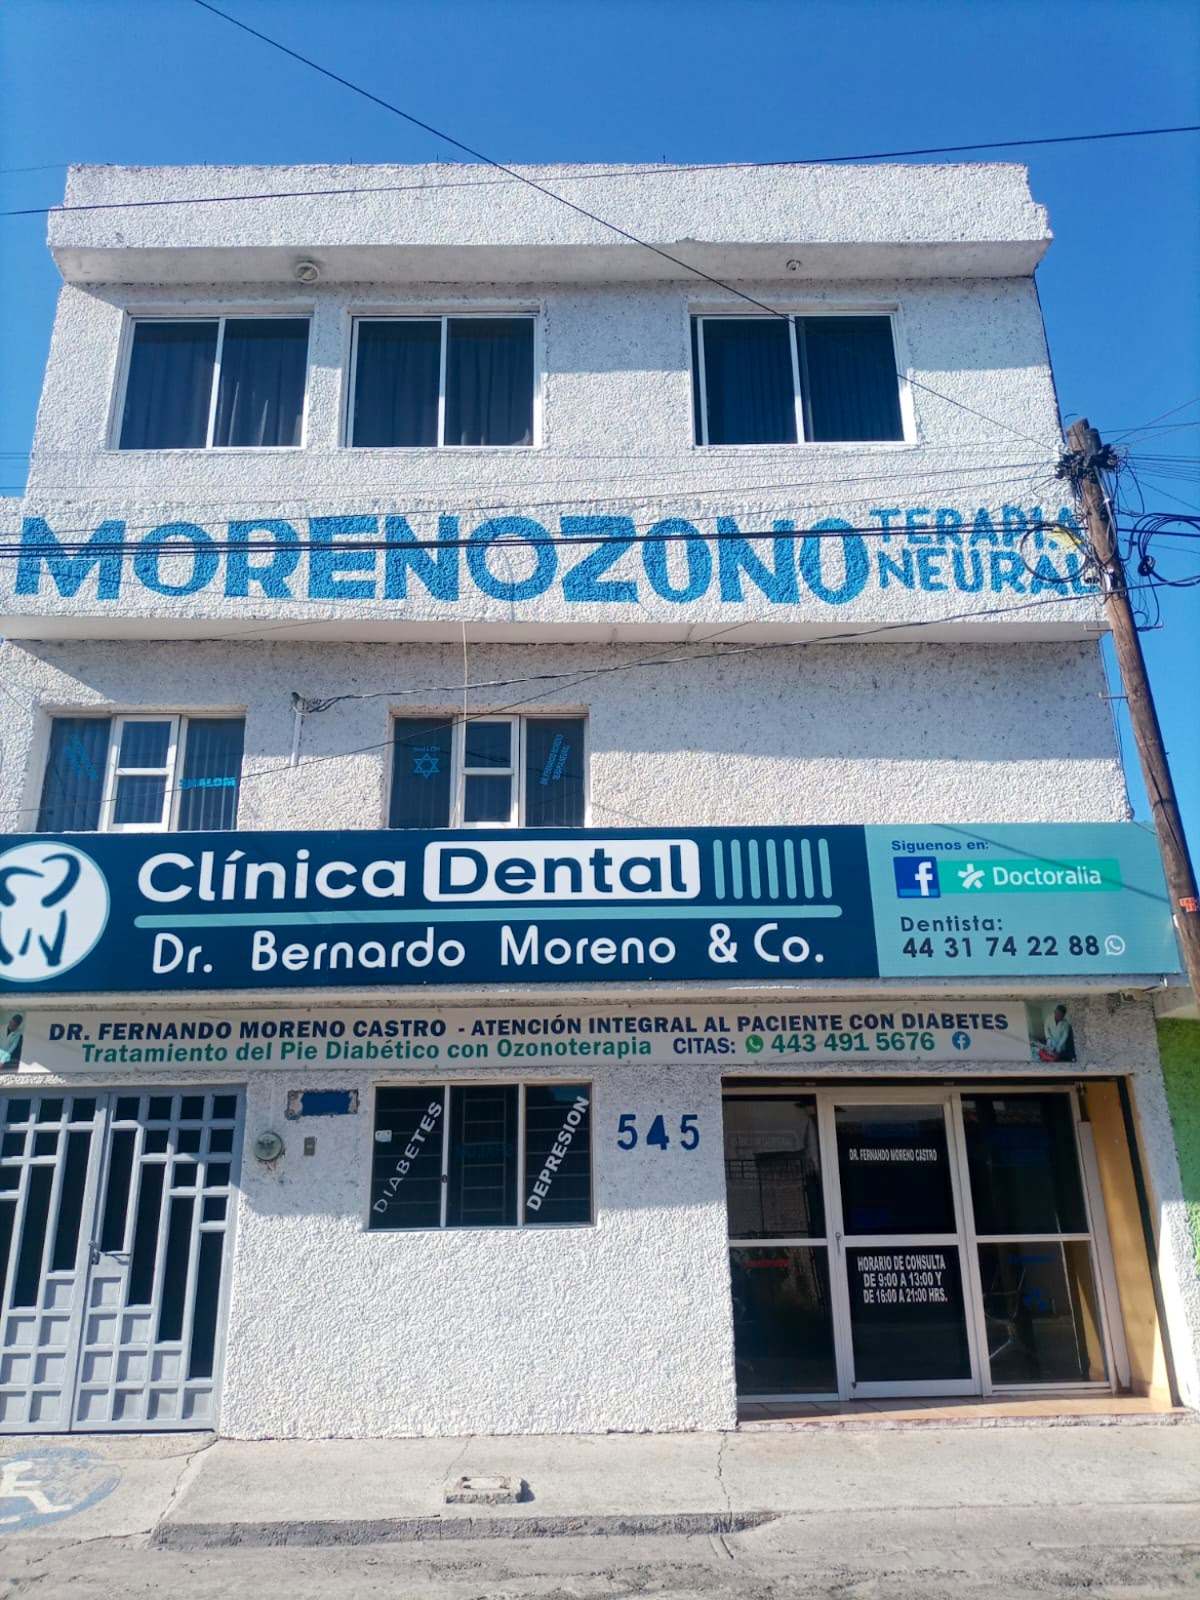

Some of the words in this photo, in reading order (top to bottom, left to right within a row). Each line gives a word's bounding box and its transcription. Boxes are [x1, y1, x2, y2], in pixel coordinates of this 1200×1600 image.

[869, 506, 1082, 549] TERAPIA
[14, 515, 870, 605] MORENOZONO
[877, 547, 1101, 596] NEURAL
[891, 840, 962, 853] Siguenos
[966, 841, 989, 850] en:
[138, 849, 406, 902] Clínica
[438, 844, 688, 895] Dental
[993, 867, 1102, 885] Doctoralia
[900, 916, 1003, 932] Dentista:
[151, 932, 214, 974] Dr.
[251, 927, 466, 972] Bernardo
[500, 924, 677, 967] Moreno
[708, 923, 738, 963] &
[754, 922, 825, 964] Co.
[903, 938, 934, 958] 44
[945, 938, 973, 957] 31
[986, 937, 1017, 956] 74
[1027, 936, 1059, 956] 22
[1069, 935, 1100, 956] 88
[49, 1023, 90, 1041] DR.
[98, 1022, 232, 1041] FERNANDO
[240, 1020, 346, 1039] MORENO
[352, 1019, 446, 1037] CASTRO
[471, 1014, 581, 1036] ATENCIÓN
[589, 1016, 697, 1034] INTEGRAL
[704, 1016, 730, 1033] AL
[737, 1014, 842, 1032] PACIENTE
[849, 1014, 895, 1031] CON
[902, 1013, 1008, 1030] DIABETES
[82, 1043, 228, 1063] Tratamiento
[236, 1042, 271, 1061] del
[281, 1042, 318, 1060] Pie
[326, 1039, 439, 1060] Diabético
[447, 1043, 489, 1058] con
[496, 1036, 652, 1059] Ozonoterapia
[673, 1037, 736, 1054] CITAS:
[771, 1034, 816, 1053] 443
[824, 1033, 870, 1052] 491
[876, 1032, 935, 1052] 5676
[617, 1113, 700, 1150] 545
[373, 1100, 442, 1214] DIABETES
[525, 1095, 590, 1212] DEPRESION
[849, 1148, 858, 1161] DR.
[860, 1148, 890, 1161] FERNANDO
[891, 1148, 914, 1161] MORENO
[916, 1148, 937, 1161] CASTRO
[857, 1255, 892, 1271] HORARIO
[893, 1255, 905, 1271] DE
[905, 1254, 946, 1270] CONSULTA
[863, 1273, 876, 1287] DE
[878, 1272, 898, 1287] 9:00
[900, 1272, 908, 1287] A
[909, 1272, 934, 1286] 13:00
[935, 1271, 942, 1286] Y
[863, 1289, 875, 1303] DE
[876, 1289, 897, 1303] 16:00
[899, 1288, 906, 1303] A
[906, 1288, 927, 1303] 21:00
[928, 1287, 948, 1302] HRS.
